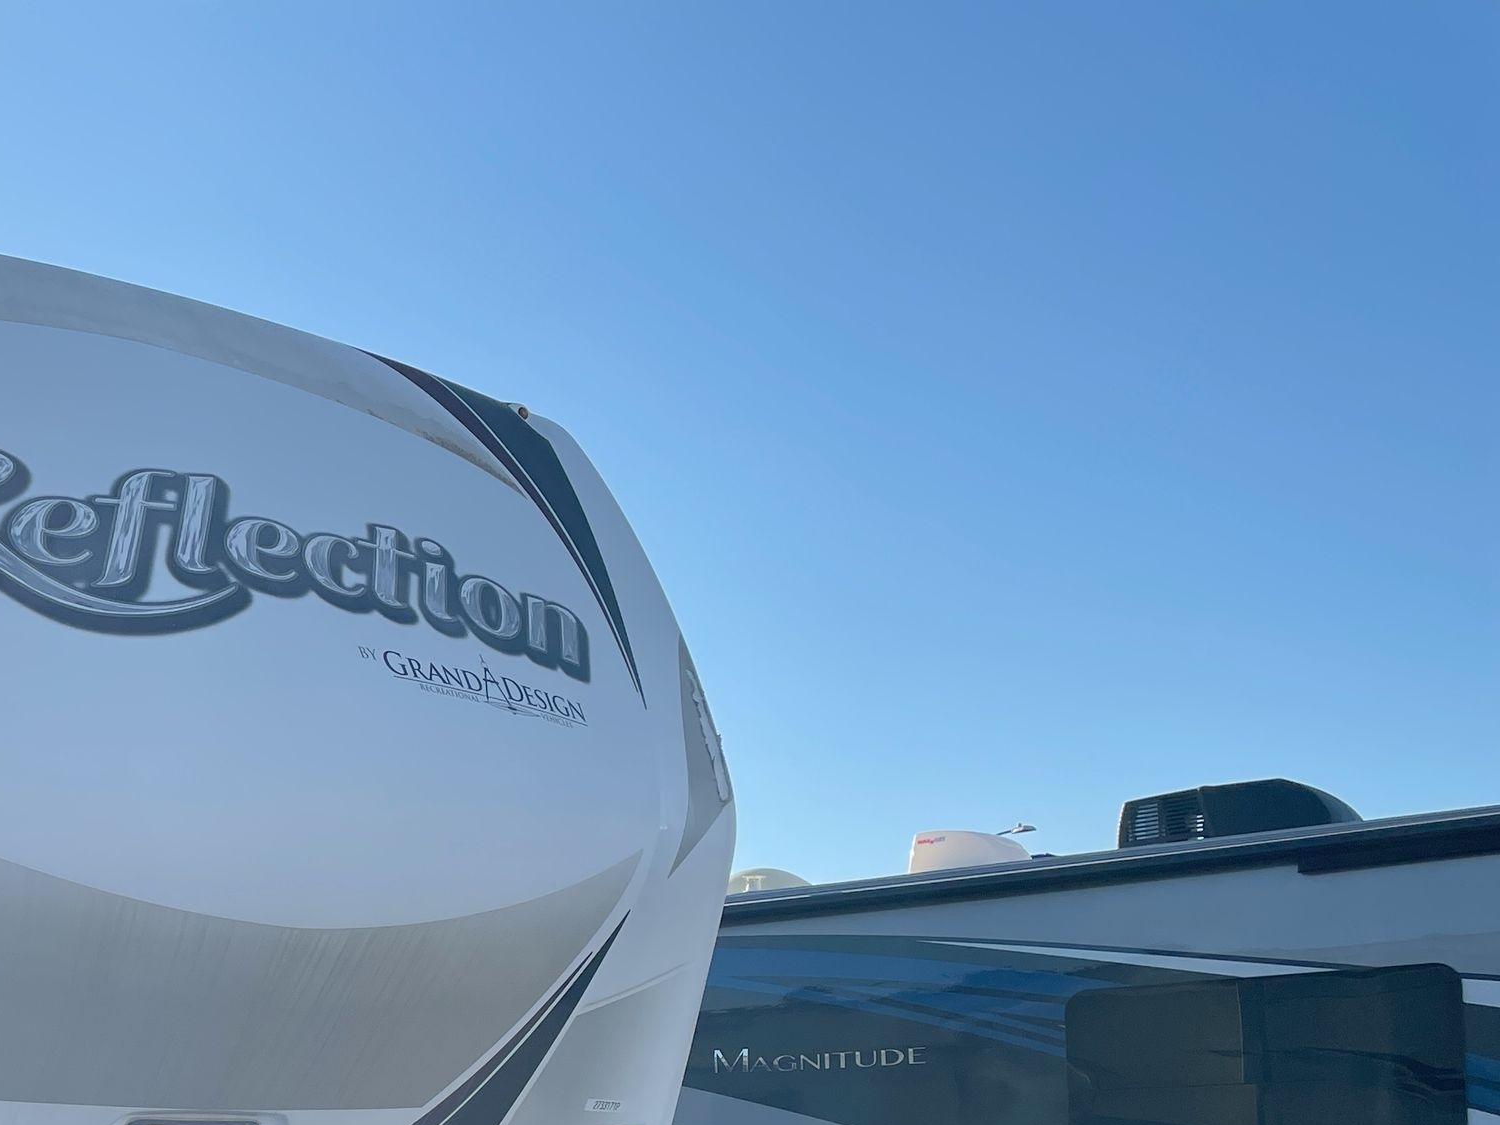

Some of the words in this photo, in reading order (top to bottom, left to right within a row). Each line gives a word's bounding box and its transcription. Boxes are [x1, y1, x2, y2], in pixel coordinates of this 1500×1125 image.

[358, 646, 378, 661] BY
[419, 683, 480, 703] RECREATIONAL
[713, 1046, 927, 1074] MAGNITUDE
